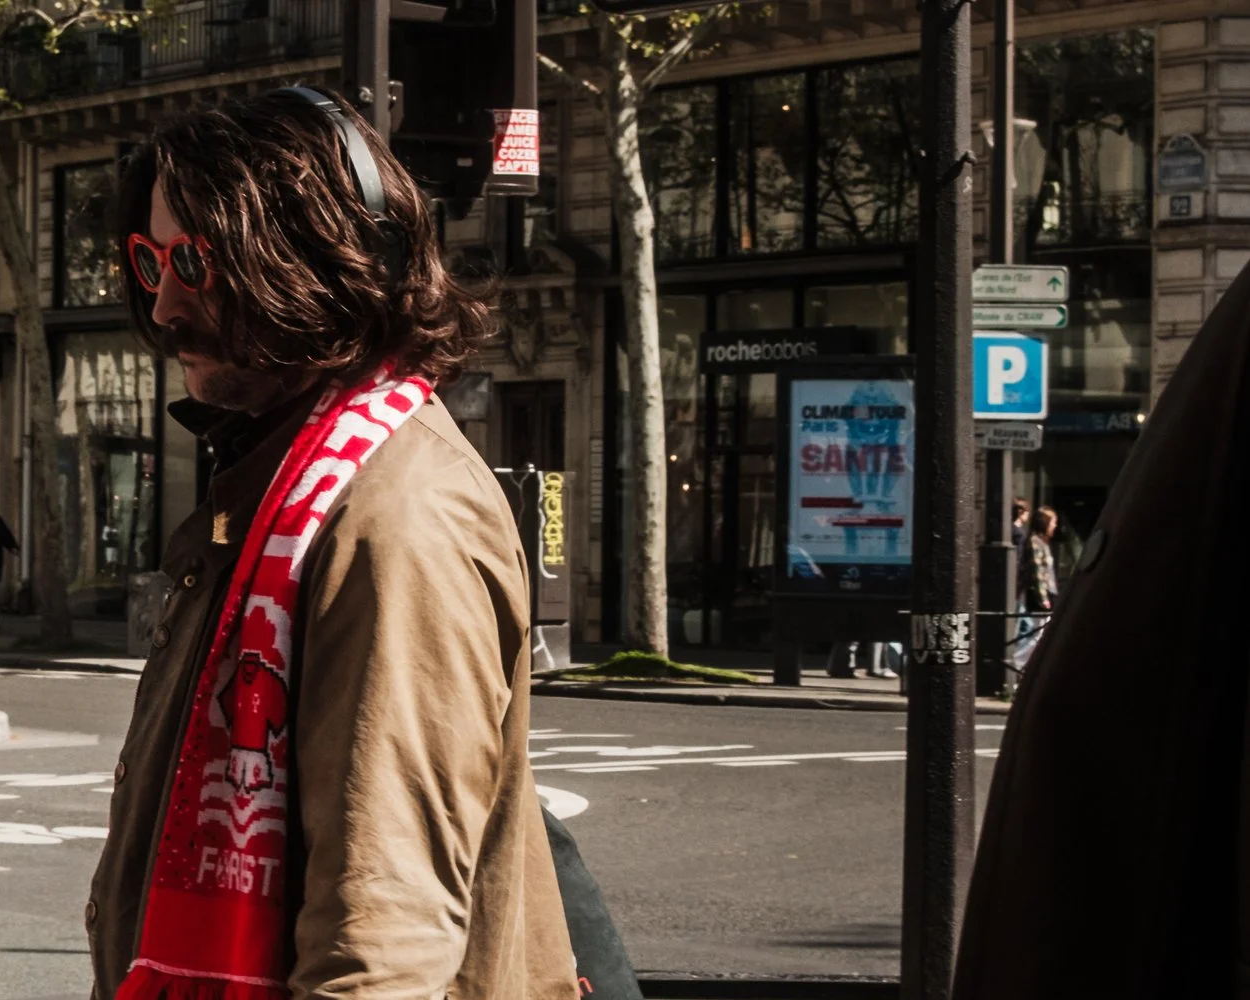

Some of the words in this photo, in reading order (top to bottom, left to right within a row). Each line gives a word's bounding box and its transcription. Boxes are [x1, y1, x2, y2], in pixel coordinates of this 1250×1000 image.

[501, 136, 535, 148] JUICE
[707, 338, 819, 361] rochebobois
[987, 346, 1028, 405] P
